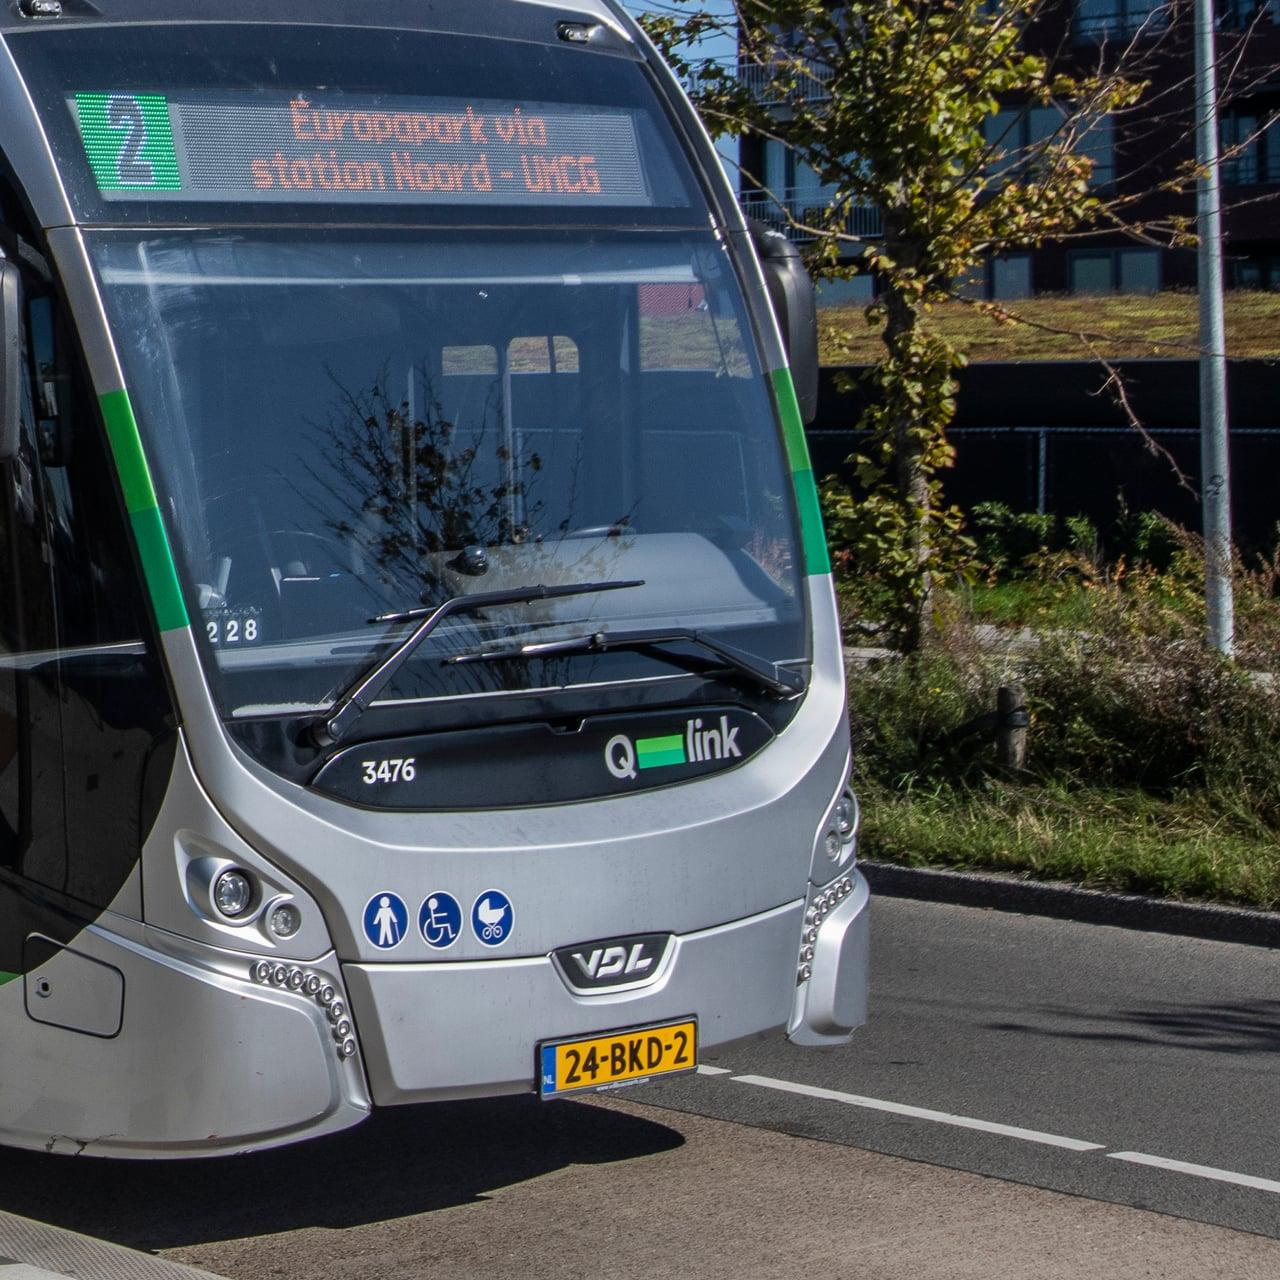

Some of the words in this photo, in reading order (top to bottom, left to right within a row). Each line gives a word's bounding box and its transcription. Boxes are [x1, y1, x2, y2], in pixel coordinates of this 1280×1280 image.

[107, 95, 156, 185] 2
[290, 99, 488, 145] Europapark
[495, 106, 547, 146] via
[251, 149, 386, 190] station
[391, 151, 492, 192] Noord
[519, 154, 601, 193] UMCG
[605, 734, 637, 780] Q
[686, 716, 742, 763] link
[362, 758, 416, 785] 3476
[571, 943, 654, 980] VDL
[543, 1074, 554, 1085] NL
[564, 1030, 689, 1085] 24-BKD-2
